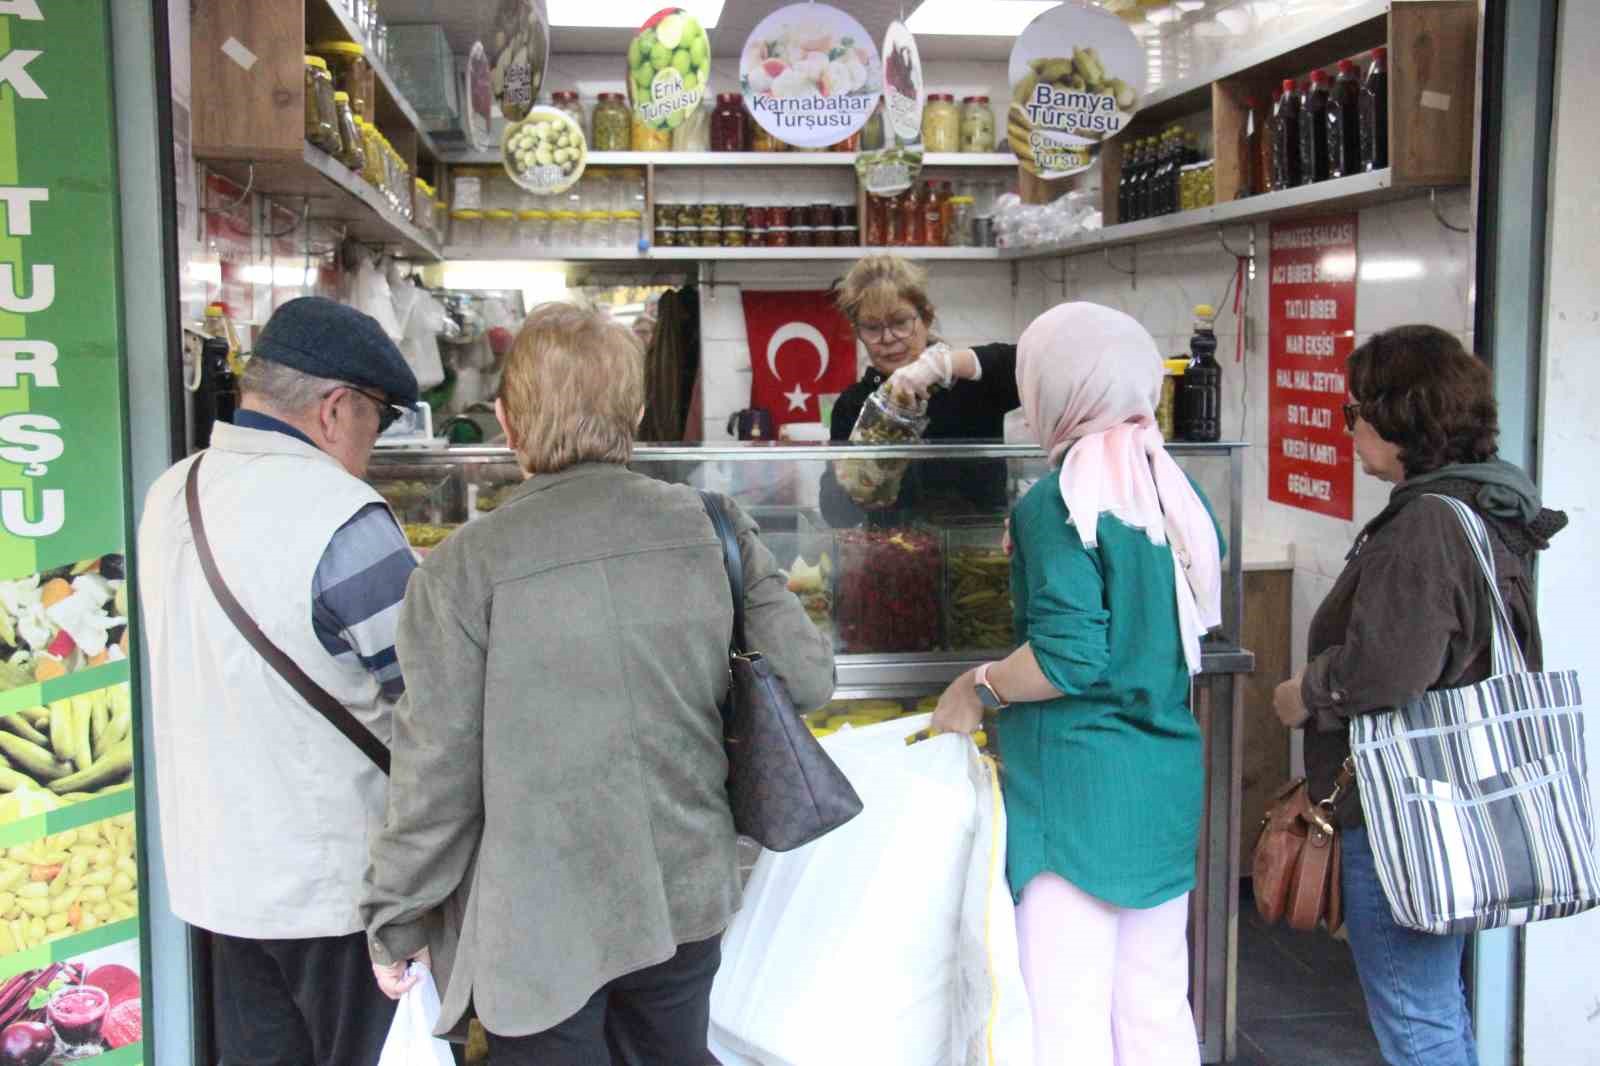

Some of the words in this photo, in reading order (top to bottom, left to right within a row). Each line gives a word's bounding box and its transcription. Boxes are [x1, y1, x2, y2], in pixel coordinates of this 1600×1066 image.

[753, 95, 869, 112] Karnabahar
[1037, 86, 1114, 113] Bamya
[773, 110, 851, 129] Turşusu
[1286, 335, 1304, 354] NAR
[0, 187, 65, 537] TURŞU
[1311, 408, 1332, 429] ALTI
[1282, 437, 1308, 460] KREDİ
[1309, 442, 1337, 465] KARTI
